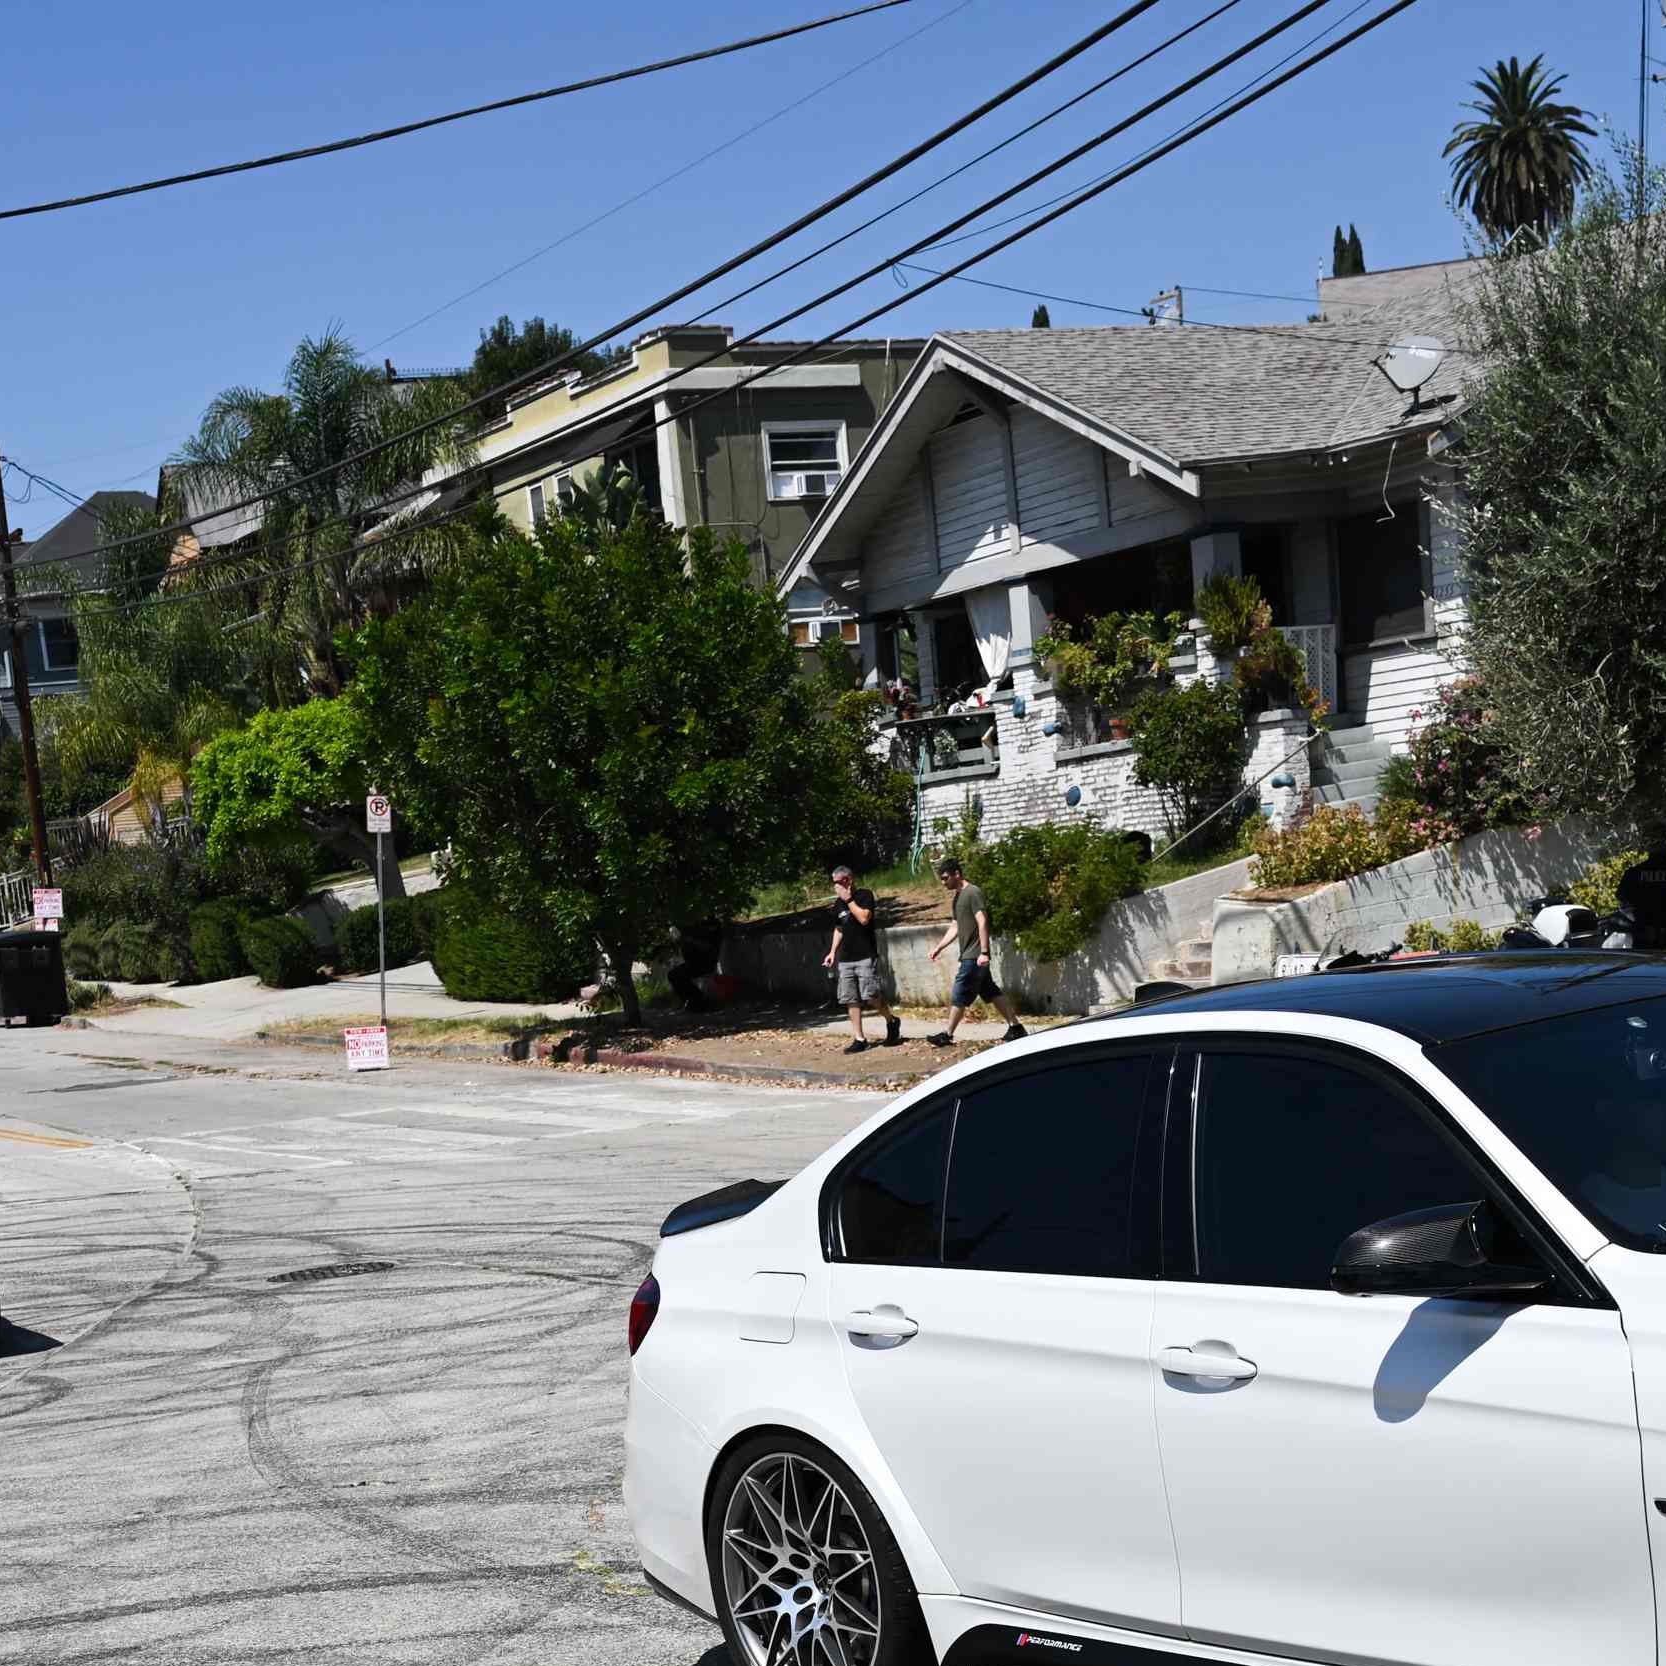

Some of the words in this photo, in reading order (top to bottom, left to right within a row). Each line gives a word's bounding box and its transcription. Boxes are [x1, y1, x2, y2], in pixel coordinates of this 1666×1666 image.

[348, 1039, 361, 1049] NO
[369, 1048, 385, 1056] TIME
[1026, 1636, 1083, 1652] PERFORMANCE
